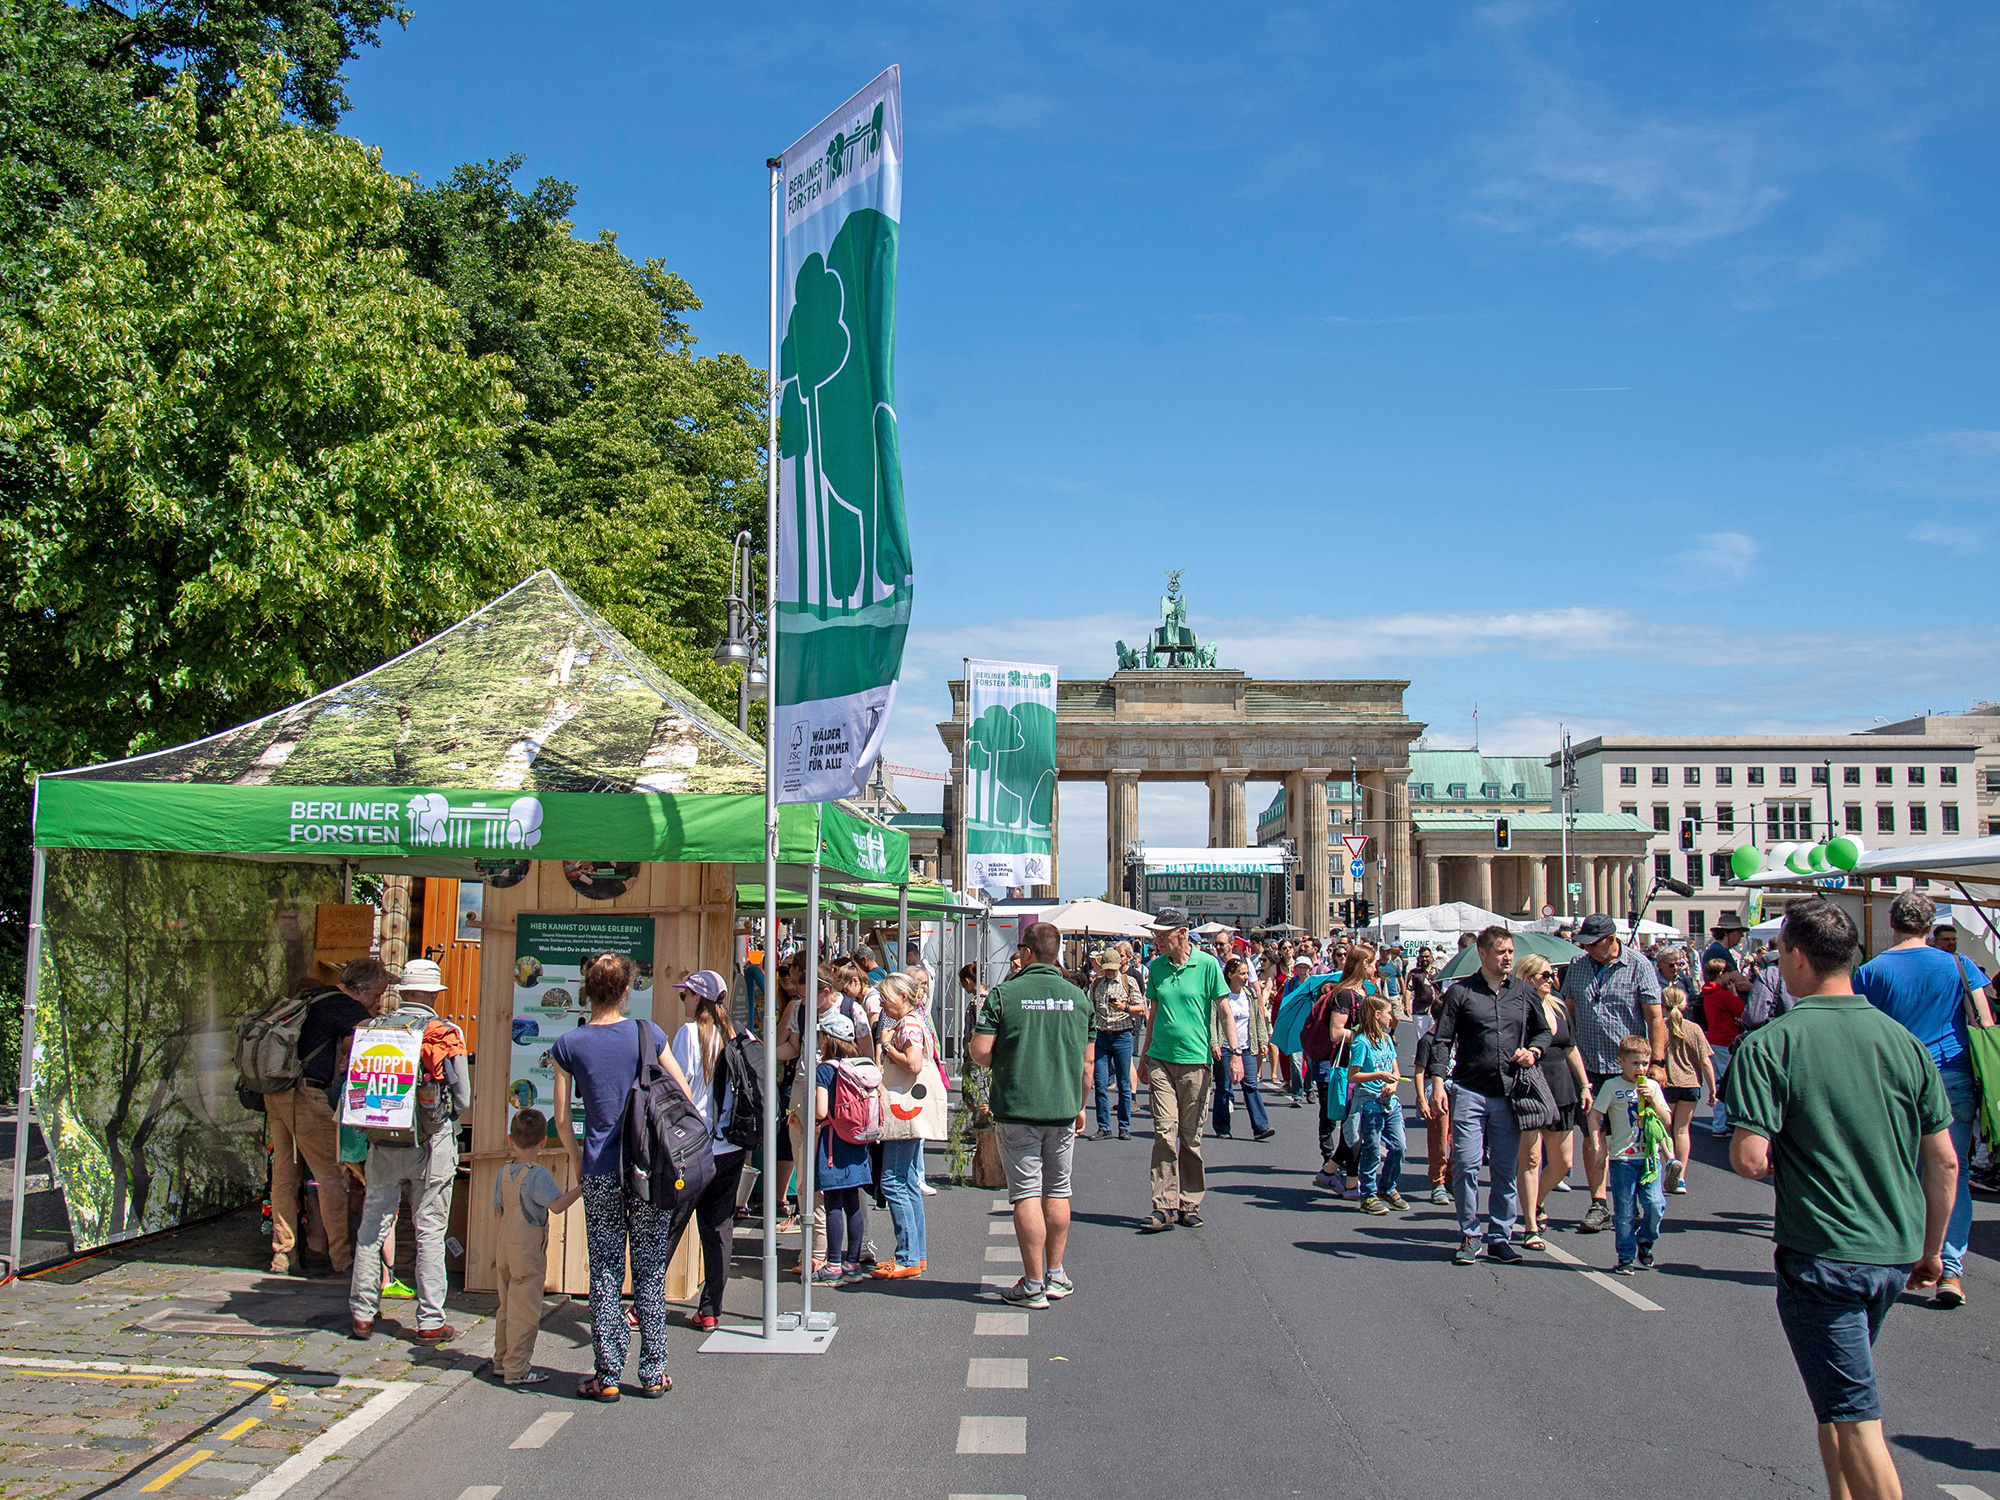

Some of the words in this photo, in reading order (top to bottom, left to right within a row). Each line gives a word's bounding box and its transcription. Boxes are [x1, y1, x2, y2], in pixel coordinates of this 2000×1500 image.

[789, 157, 823, 197] BERLINER
[788, 177, 822, 217] FORSTEN
[976, 679, 1006, 687] FORSTEN
[812, 727, 841, 742] WÄLDER
[809, 743, 823, 757] FÜR
[825, 742, 849, 755] IMMER
[808, 758, 823, 771] FÜR
[825, 758, 842, 770] ALLE
[291, 801, 400, 821] BERLINER
[290, 824, 400, 844] FORSTEN
[1168, 864, 1270, 873] UMWELTFESTIVAL
[1148, 877, 1259, 891] UMWELTFESTIVAL
[548, 923, 577, 931] KANNST
[608, 925, 642, 933] ERLEBEN!
[1404, 939, 1430, 948] GRÜNE
[355, 1055, 409, 1074] STOPPT
[366, 1074, 399, 1096] AFD
[1615, 1089, 1635, 1099] SO
